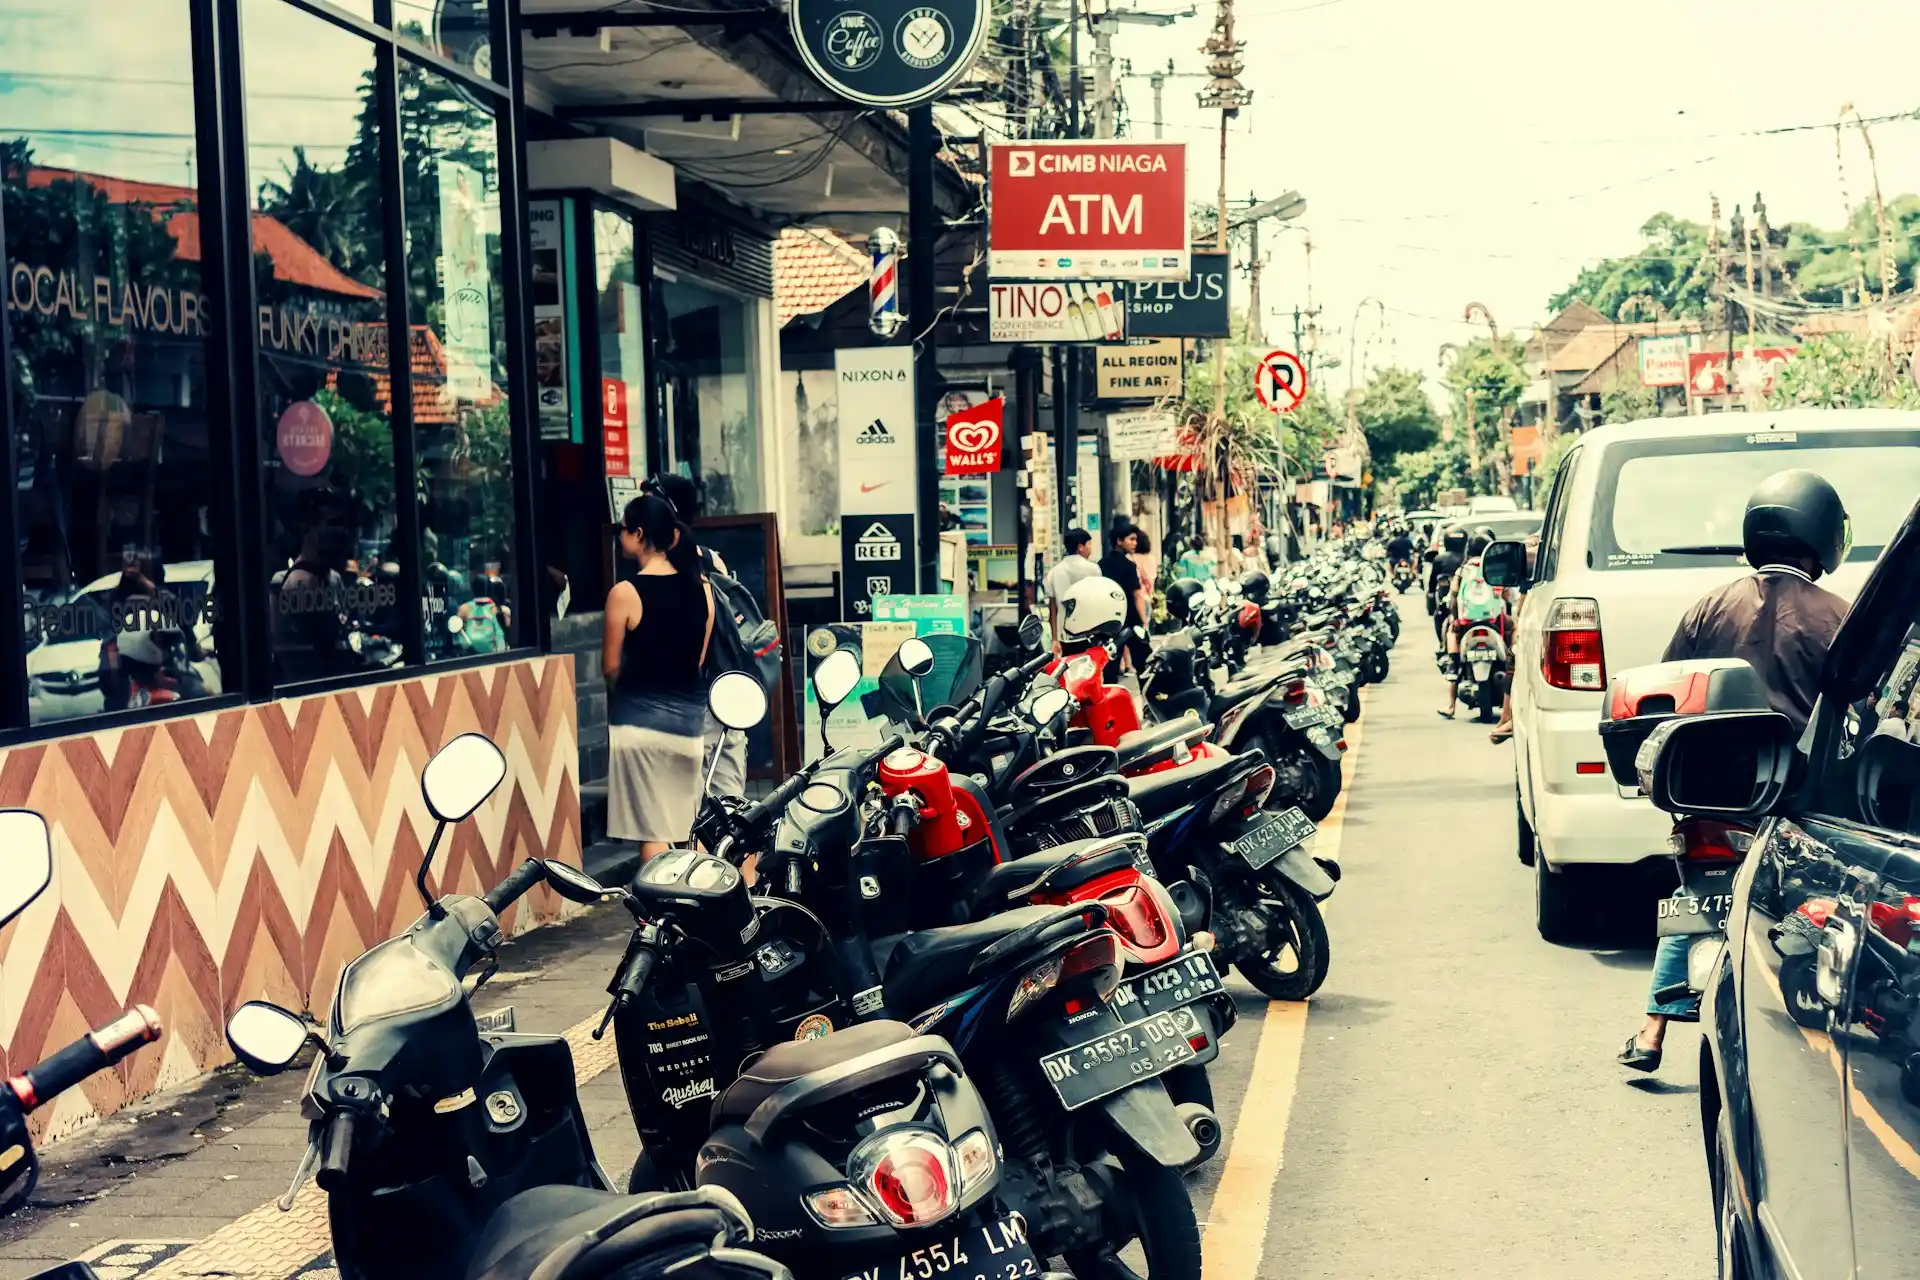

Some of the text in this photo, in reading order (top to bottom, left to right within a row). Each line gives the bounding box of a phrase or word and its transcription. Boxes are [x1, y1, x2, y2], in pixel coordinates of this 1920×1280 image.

[839, 16, 865, 28] VNUE
[828, 28, 880, 58] Coffee
[1038, 153, 1167, 173] CIMB NIAGA
[1038, 194, 1143, 235] ATM
[1134, 273, 1224, 300] PLUS
[7, 262, 213, 337] LOCAL FLAVOURS
[991, 285, 1063, 318] TINO
[258, 305, 389, 366] FUNKY DRINKS
[991, 320, 1065, 331] CONVENIENCE
[991, 330, 1034, 340] MARKET
[1102, 355, 1178, 367] ALL REGION
[842, 370, 893, 382] NIXON
[1110, 375, 1171, 388] FINE ART
[856, 434, 896, 445] adidas
[949, 451, 997, 467] WALL'S
[858, 545, 898, 558] REEF
[1239, 835, 1259, 855] DK
[1280, 809, 1305, 831] UAB
[1658, 894, 1733, 919] DK 5475
[1114, 956, 1210, 1007] DK 4123 IR
[647, 1012, 698, 1031] The Sebali
[1067, 1010, 1099, 1025] HONDA
[647, 1033, 709, 1054] 703 SWEET ROCK BALI
[1045, 1017, 1176, 1082] DK 3562 DG
[657, 1055, 710, 1073] WEDNEST
[661, 1078, 715, 1107] Huskey
[857, 1100, 905, 1118] HONDA
[900, 1217, 1027, 1280] 4554 LM
